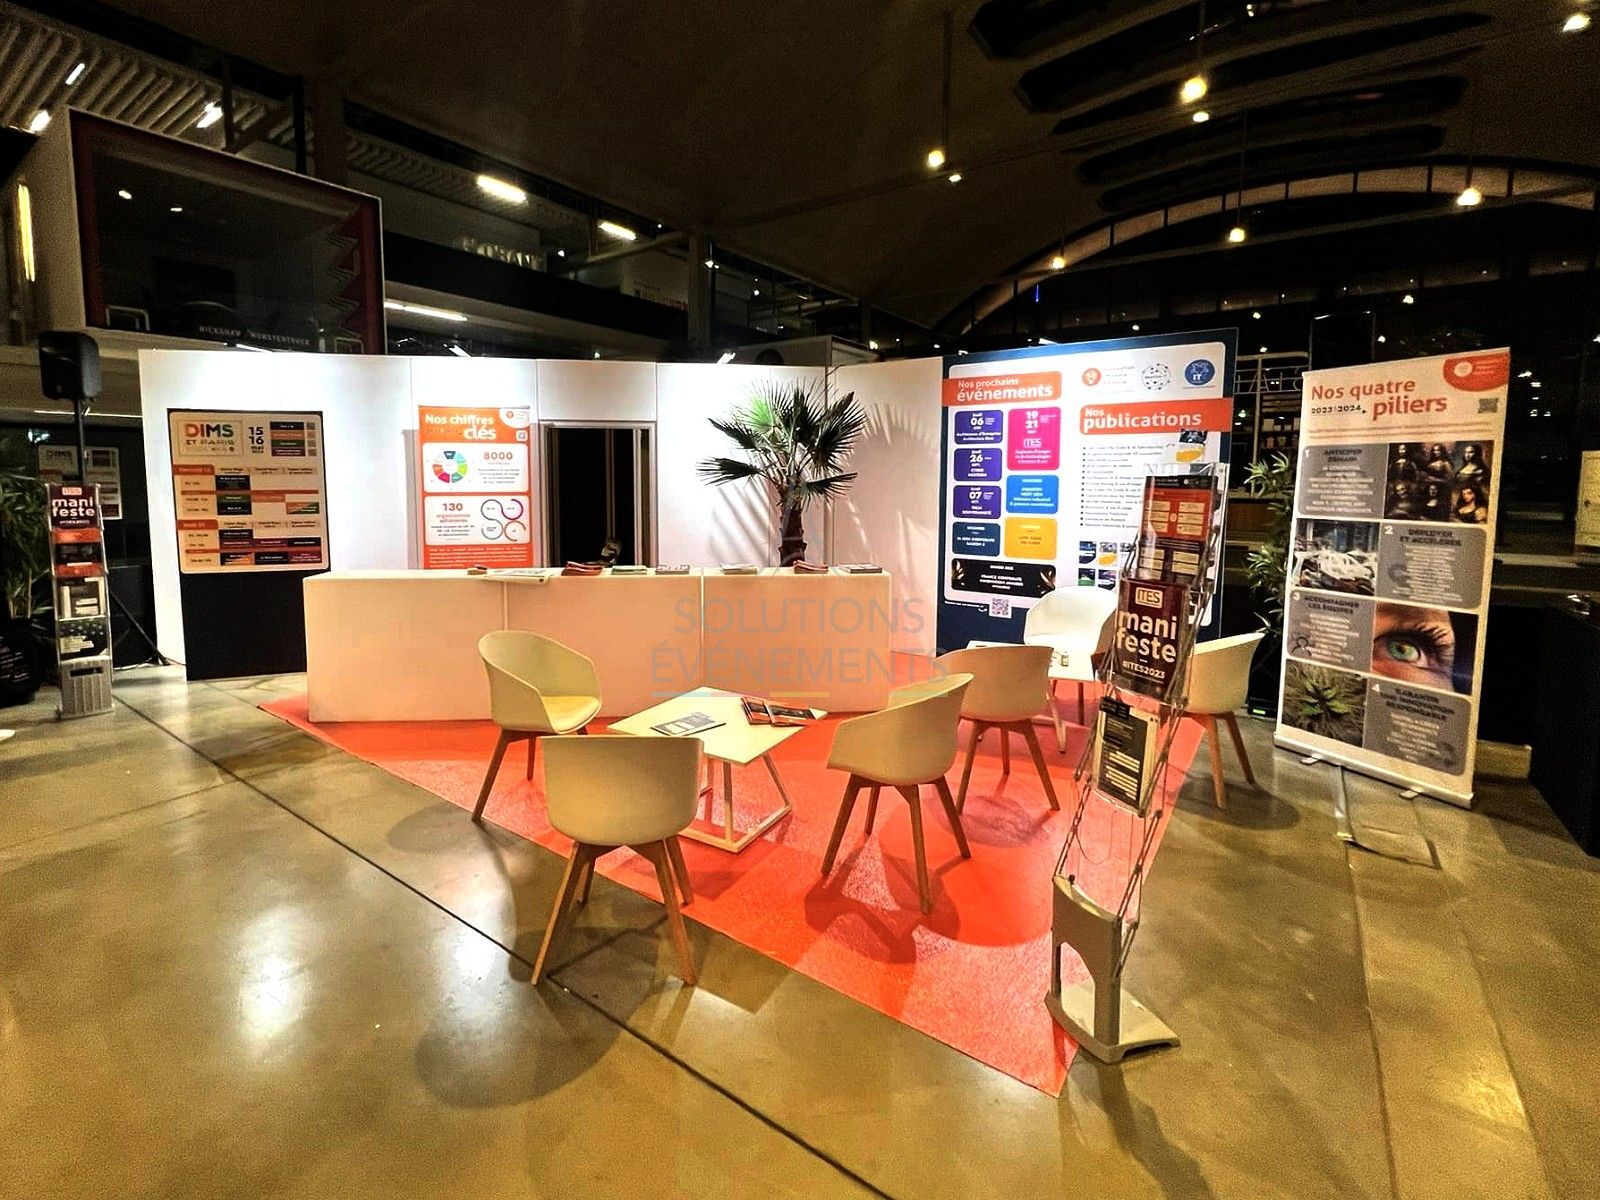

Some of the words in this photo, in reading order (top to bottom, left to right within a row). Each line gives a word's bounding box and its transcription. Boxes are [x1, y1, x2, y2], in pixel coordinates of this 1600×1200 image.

[958, 380, 975, 389] Nos
[975, 377, 1019, 390] prochains
[957, 384, 1054, 402] événements
[1311, 385, 1345, 400] Nos
[1349, 380, 1416, 401] quatre
[1085, 407, 1105, 416] Nos
[1372, 395, 1449, 421] piliers
[425, 413, 447, 424] Nos
[450, 414, 495, 426] chiffres
[970, 417, 984, 426] 06
[1083, 411, 1202, 434] publications
[184, 424, 234, 438] DIMS
[248, 426, 264, 435] 15
[464, 424, 497, 440] clés
[248, 435, 264, 445] 16
[484, 452, 513, 460] 8000
[970, 454, 983, 463] 26
[52, 496, 94, 507] mani
[969, 491, 983, 500] 07
[52, 506, 95, 517] feste
[442, 503, 463, 511] 130
[1384, 525, 1394, 535] 2
[1137, 590, 1160, 604] ITES
[1118, 610, 1177, 640] mani
[1116, 627, 1177, 663] feste
